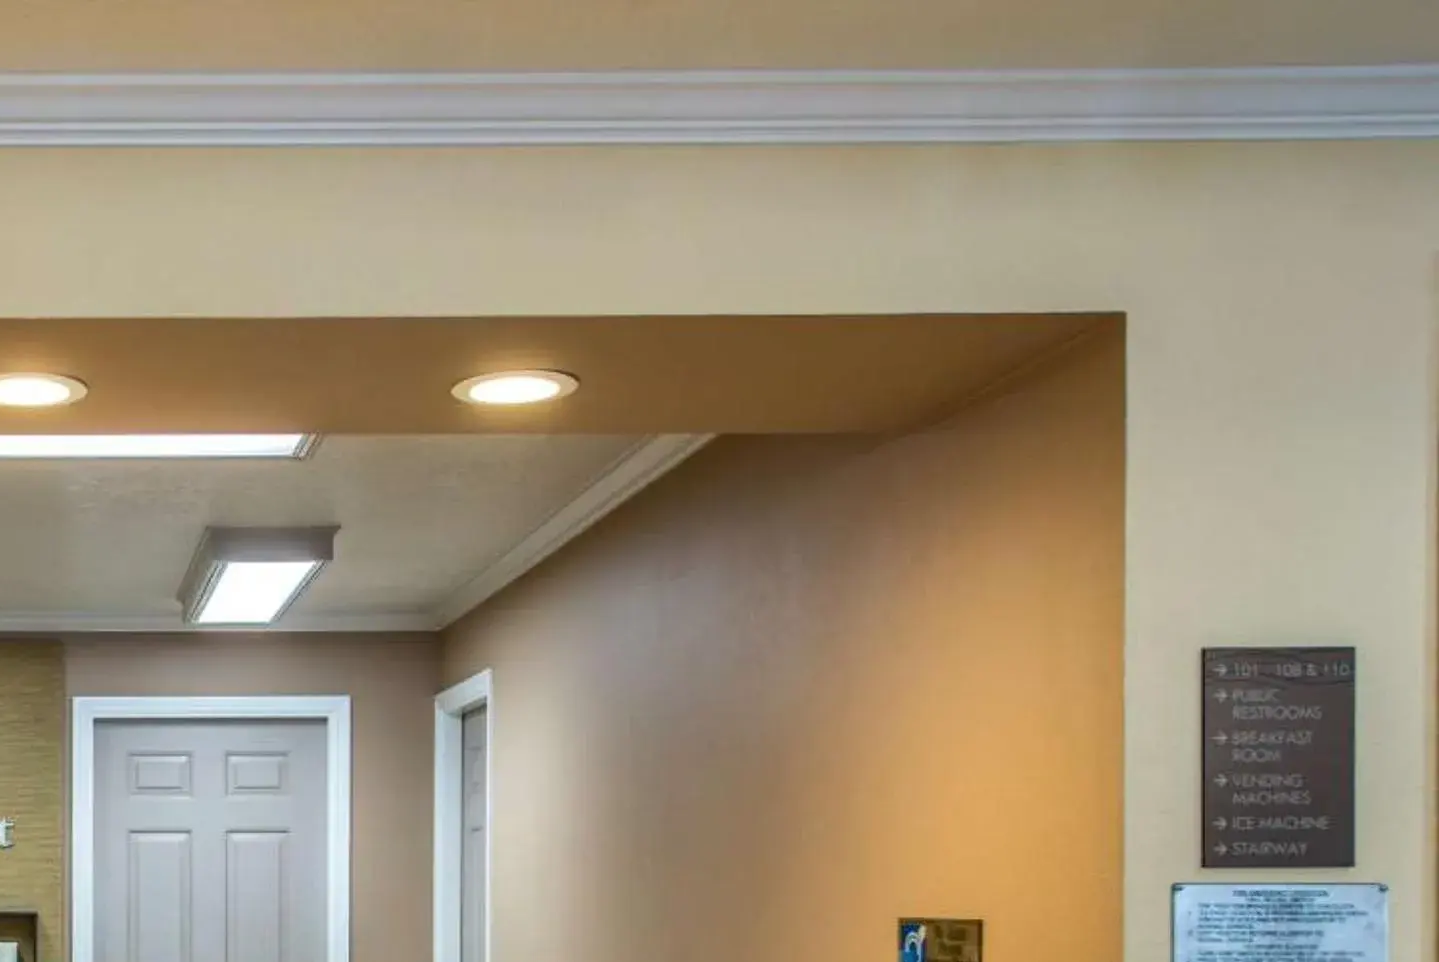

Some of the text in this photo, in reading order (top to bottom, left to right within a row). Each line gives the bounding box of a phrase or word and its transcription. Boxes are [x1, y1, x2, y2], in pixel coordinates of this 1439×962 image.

[1232, 687, 1280, 703] PUBLIC
[1232, 705, 1322, 721] RESTROOMS
[1231, 730, 1313, 745] BREAKFAST
[1231, 747, 1281, 763] ROOM
[1231, 773, 1304, 788] VENDING
[1231, 789, 1311, 806] MACHINES
[1231, 816, 1331, 831] ICE MACHINE
[1231, 841, 1308, 856] STAIRWAY
